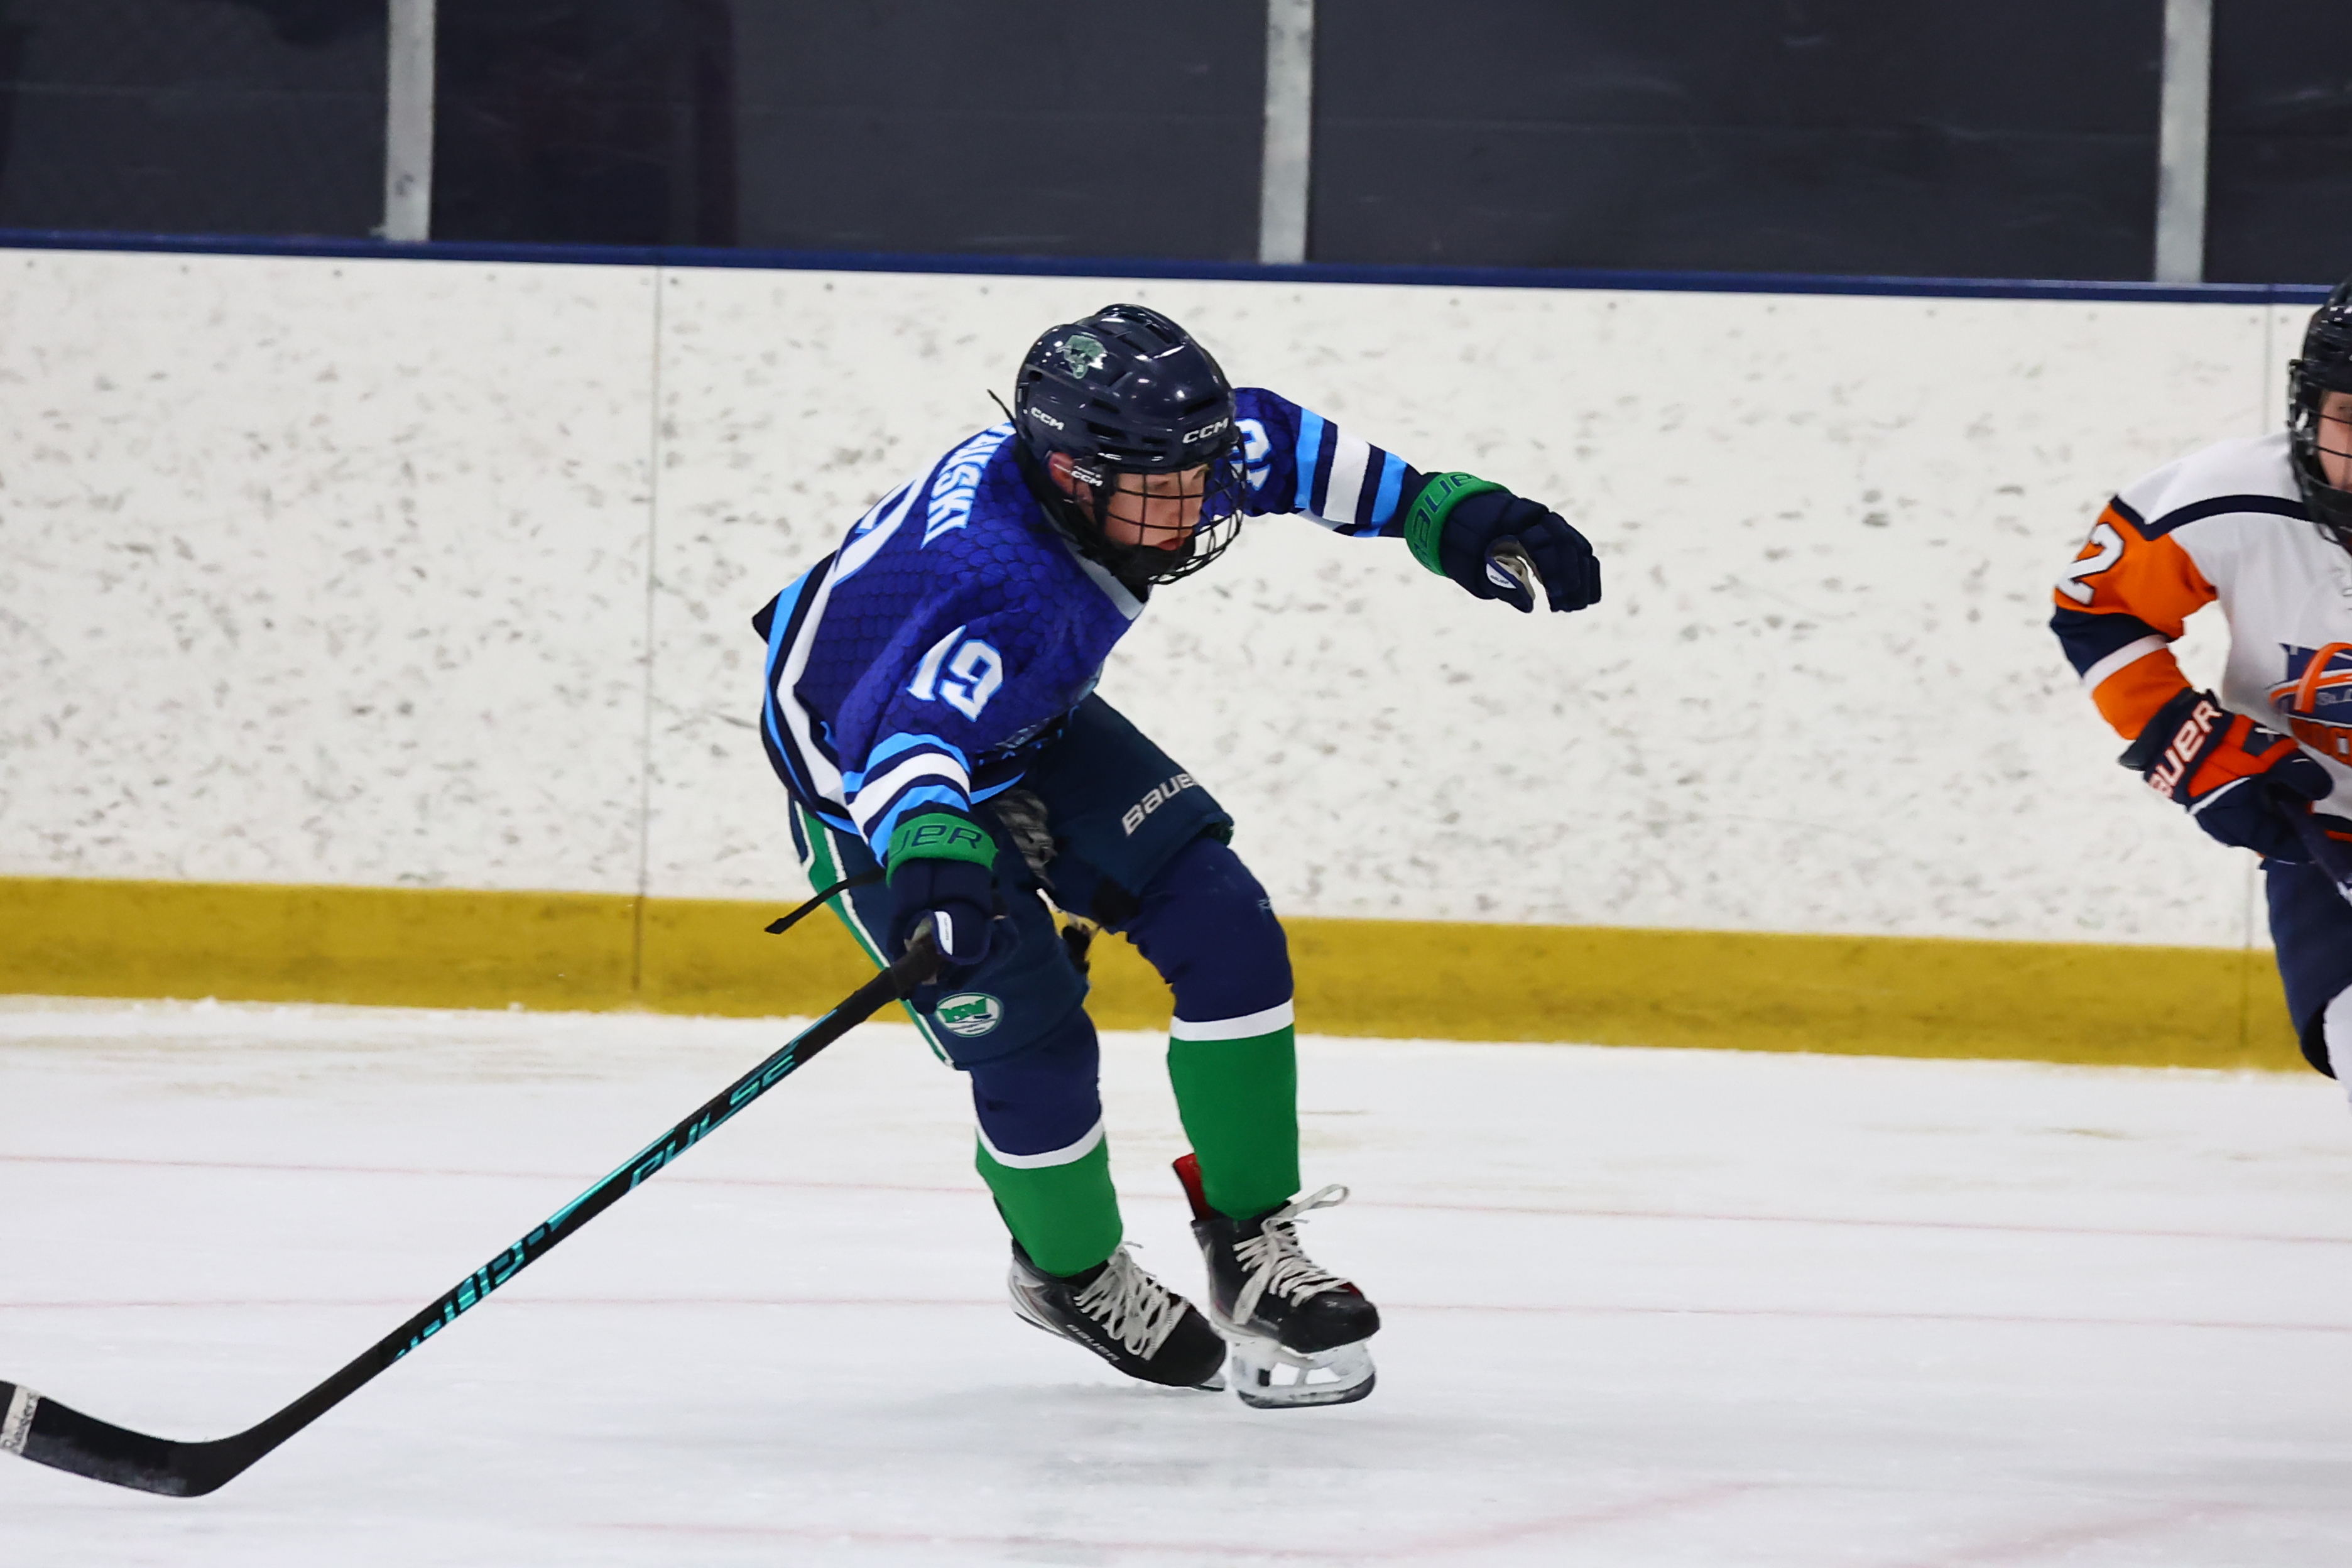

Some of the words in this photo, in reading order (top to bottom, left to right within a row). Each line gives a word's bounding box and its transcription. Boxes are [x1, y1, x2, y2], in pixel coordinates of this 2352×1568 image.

[1030, 406, 1065, 431] CCM
[1182, 417, 1229, 444] CCM
[1071, 471, 1104, 487] CCM
[2054, 523, 2125, 605] 2
[907, 625, 1003, 722] 19
[1121, 773, 1199, 837] BAUE
